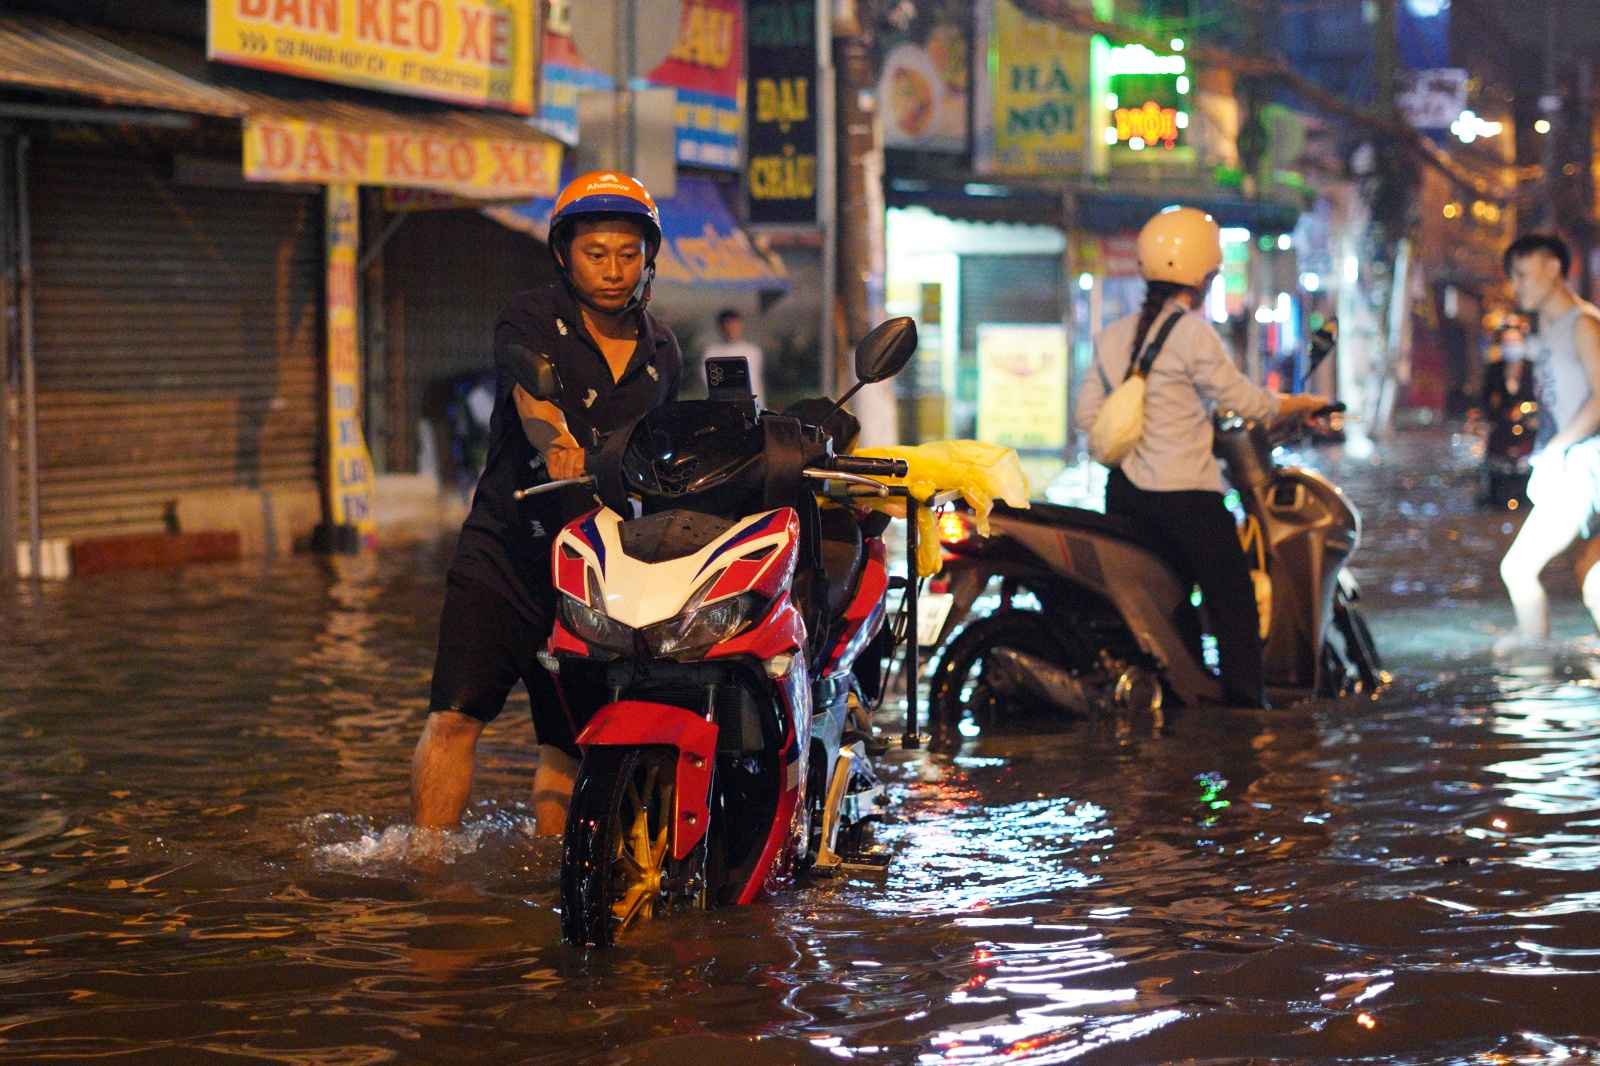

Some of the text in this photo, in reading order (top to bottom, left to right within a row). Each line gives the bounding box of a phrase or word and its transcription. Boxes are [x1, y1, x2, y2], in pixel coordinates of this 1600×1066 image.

[357, 0, 442, 52] KEO
[458, 8, 511, 68] XE
[1008, 58, 1073, 92] HÀ
[1007, 101, 1075, 138] NỘI
[387, 136, 477, 182] KEO
[490, 141, 547, 185] XE
[586, 182, 631, 192] Ahamove
